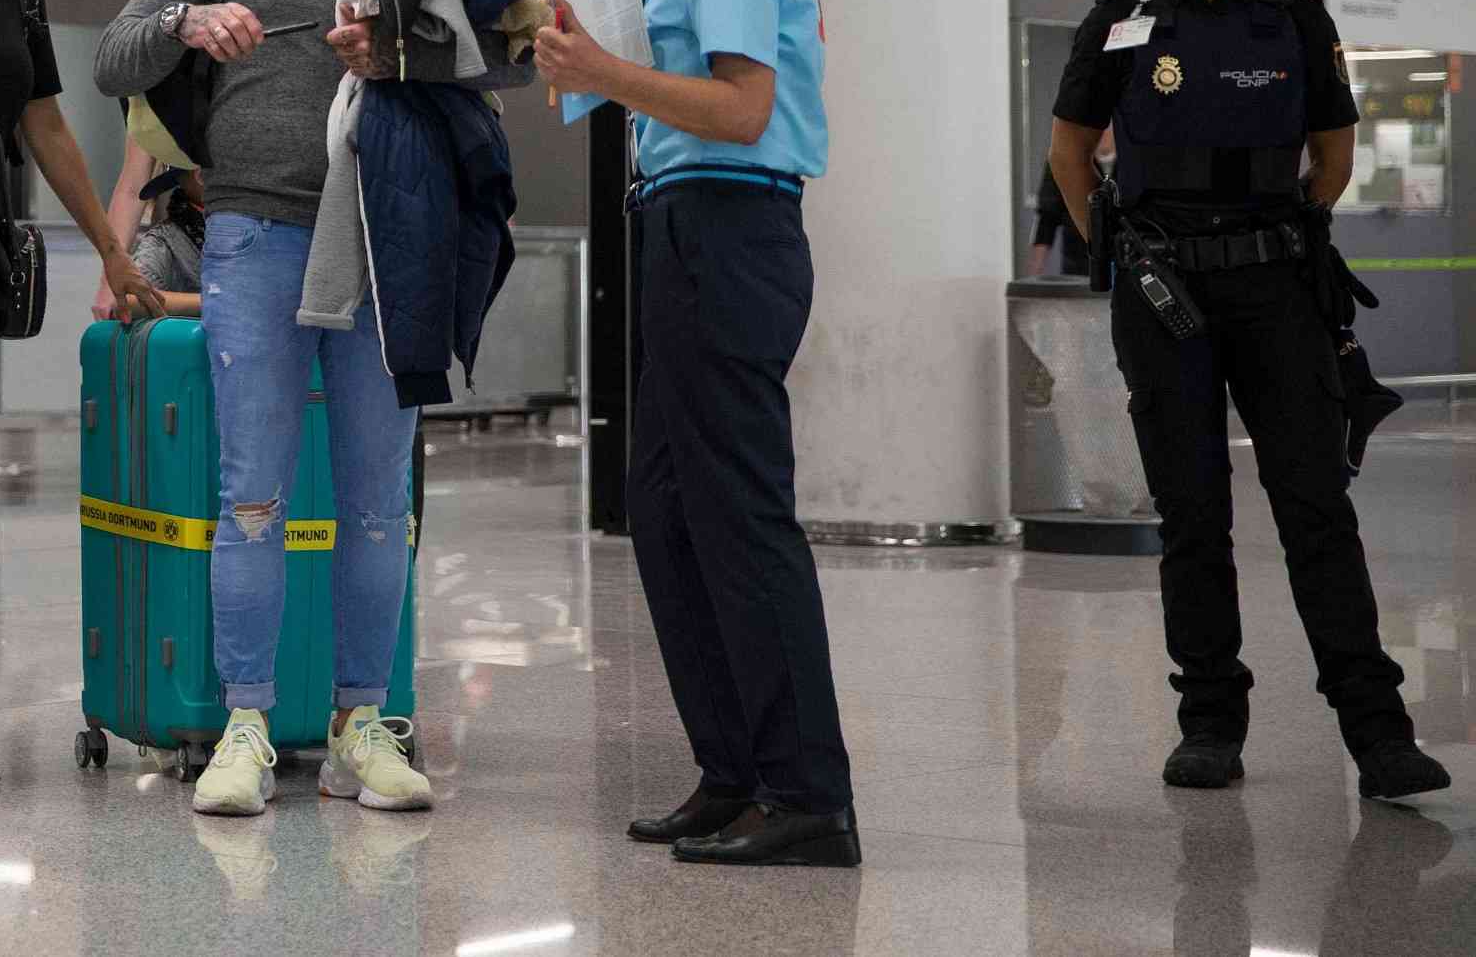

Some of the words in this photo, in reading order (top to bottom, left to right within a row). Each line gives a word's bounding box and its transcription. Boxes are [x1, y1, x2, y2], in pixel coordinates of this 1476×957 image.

[1220, 70, 1277, 80] POLICIA
[1237, 79, 1269, 88] CNP
[80, 504, 107, 521] RUSSIA
[108, 511, 157, 533] DORTMUND
[284, 529, 328, 542] RTMUND
